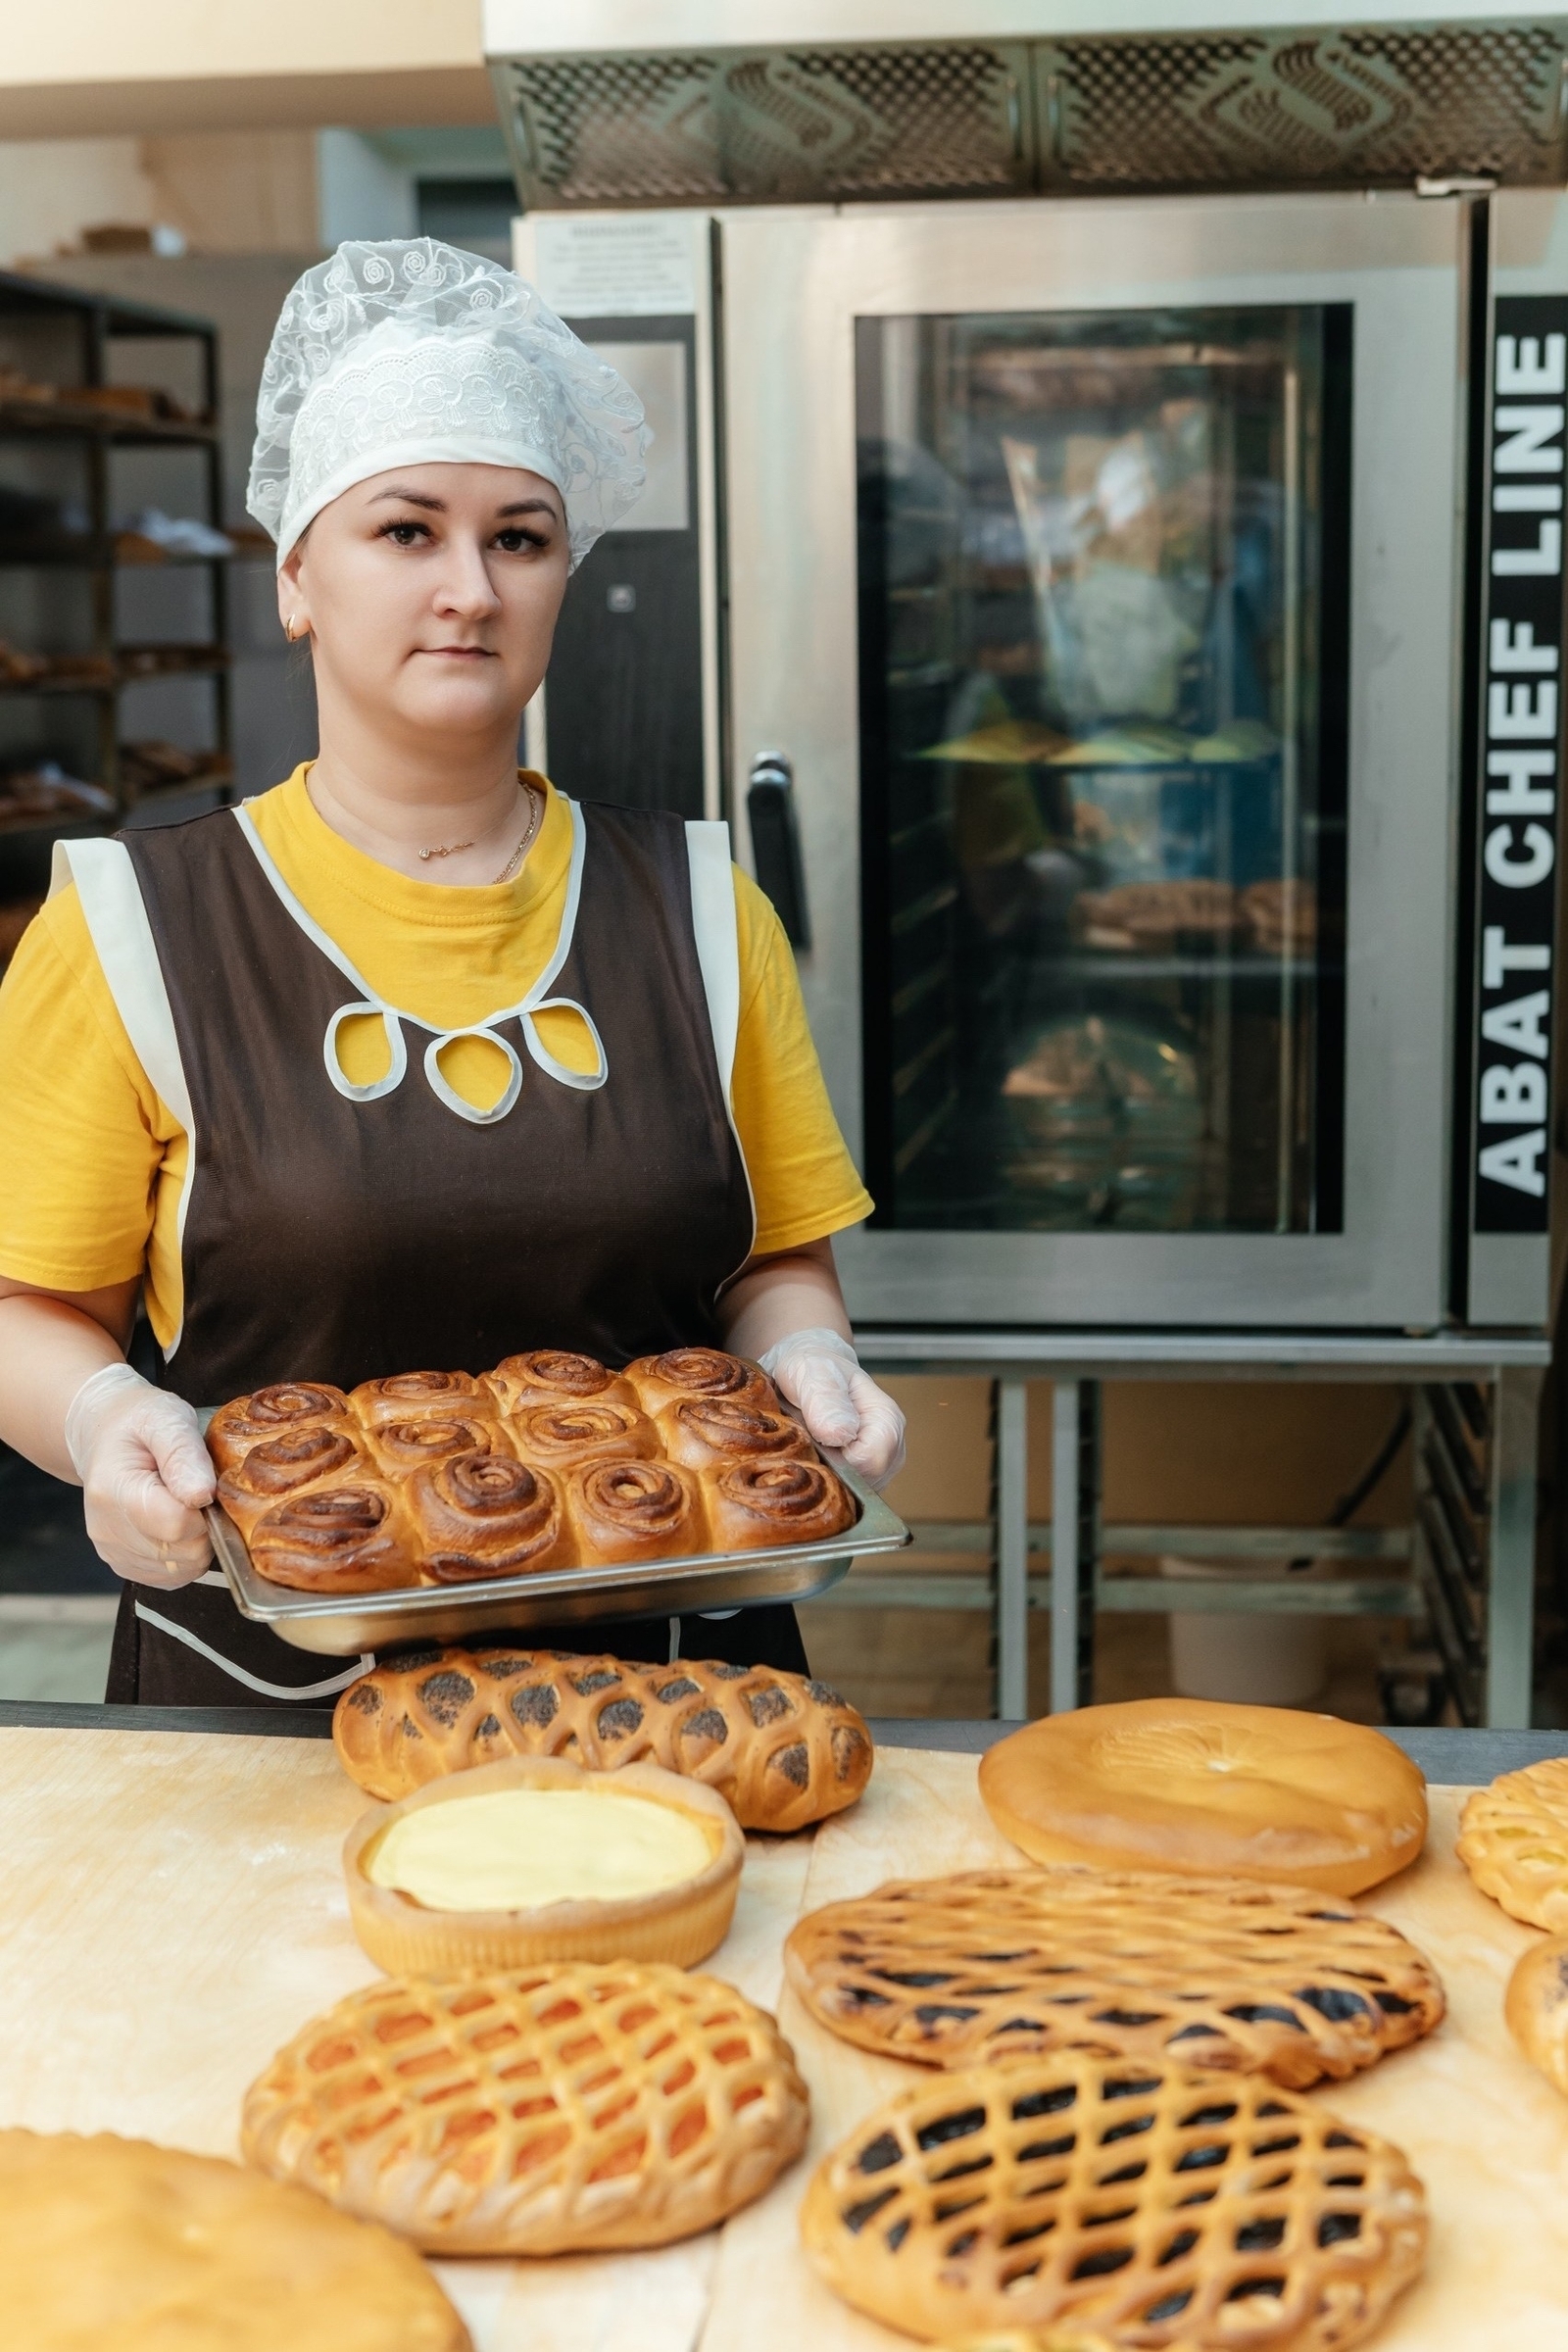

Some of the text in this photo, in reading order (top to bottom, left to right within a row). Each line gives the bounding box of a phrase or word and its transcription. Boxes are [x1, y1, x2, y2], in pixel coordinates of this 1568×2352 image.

[1479, 333, 1566, 1197] ABAT CHEF LINE
